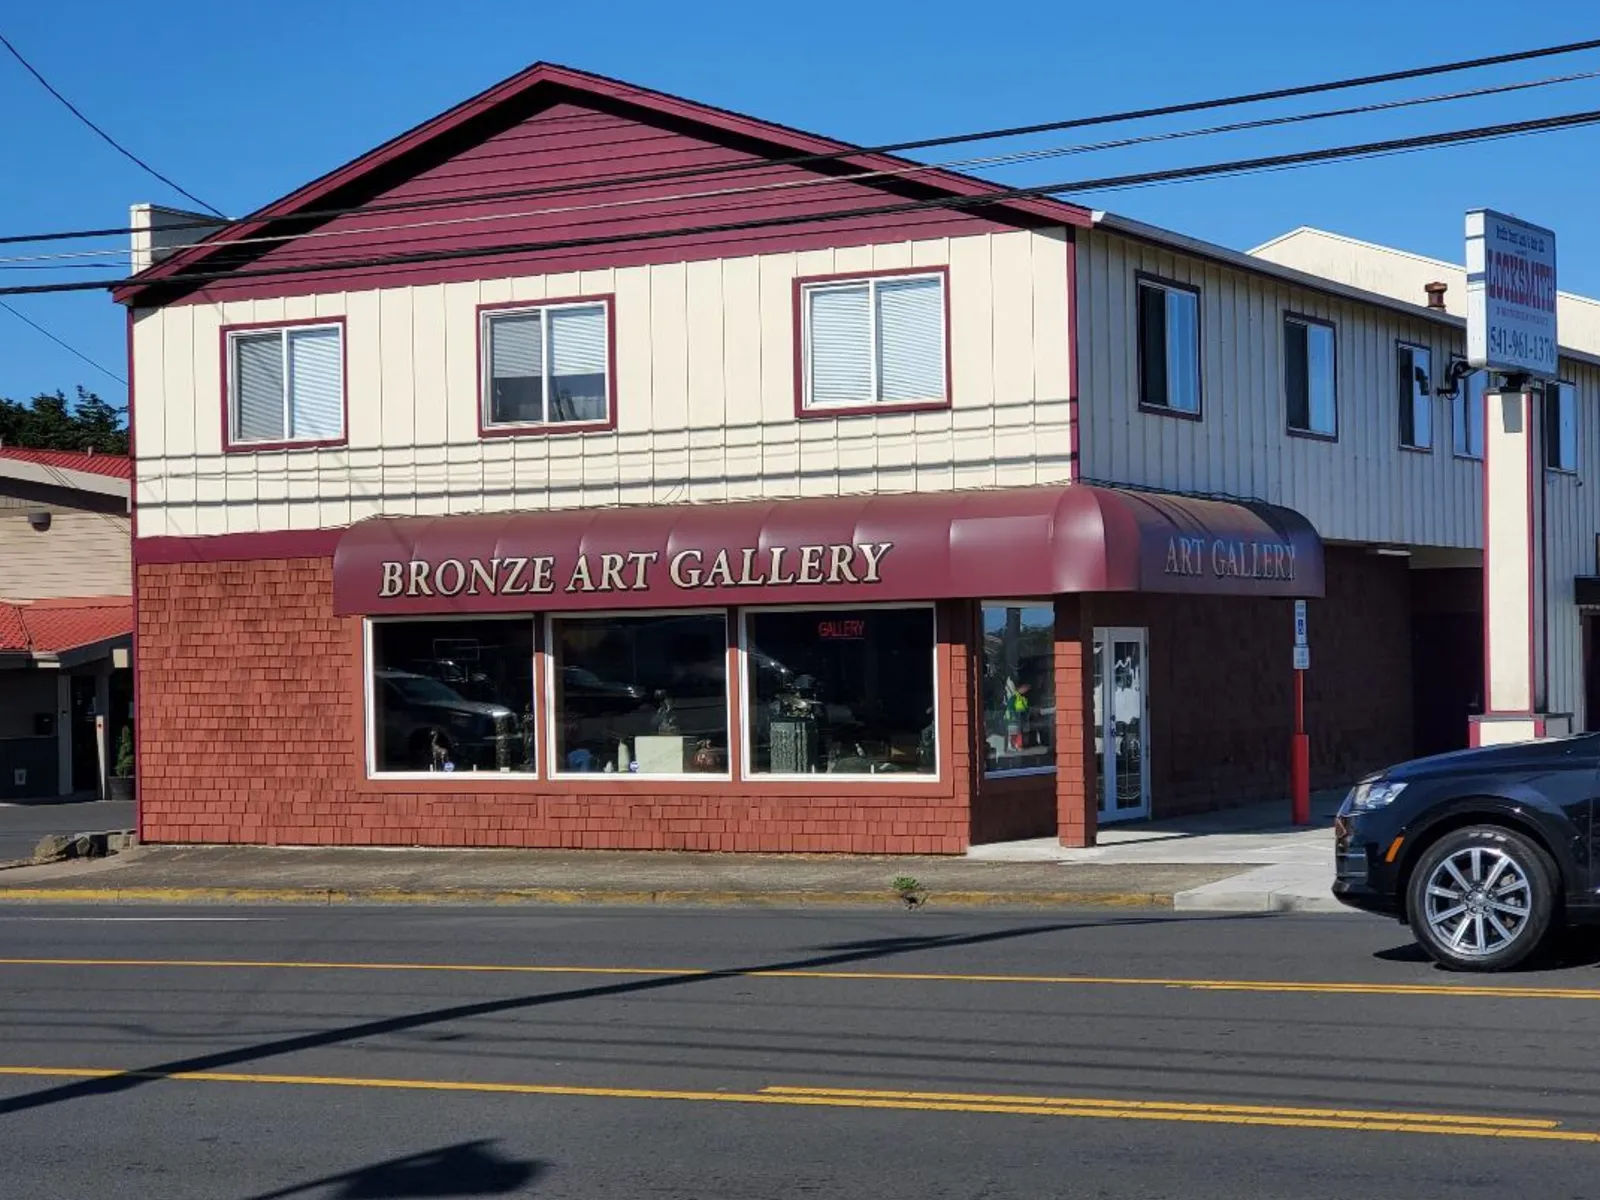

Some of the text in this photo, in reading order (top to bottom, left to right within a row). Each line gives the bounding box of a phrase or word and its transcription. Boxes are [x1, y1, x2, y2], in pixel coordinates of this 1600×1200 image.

[1488, 249, 1555, 313] LOCKSMITH
[379, 542, 893, 597] BRONZE ART GALLERY
[1165, 536, 1295, 581] ART GALLERY
[817, 620, 865, 637] GALLERY
